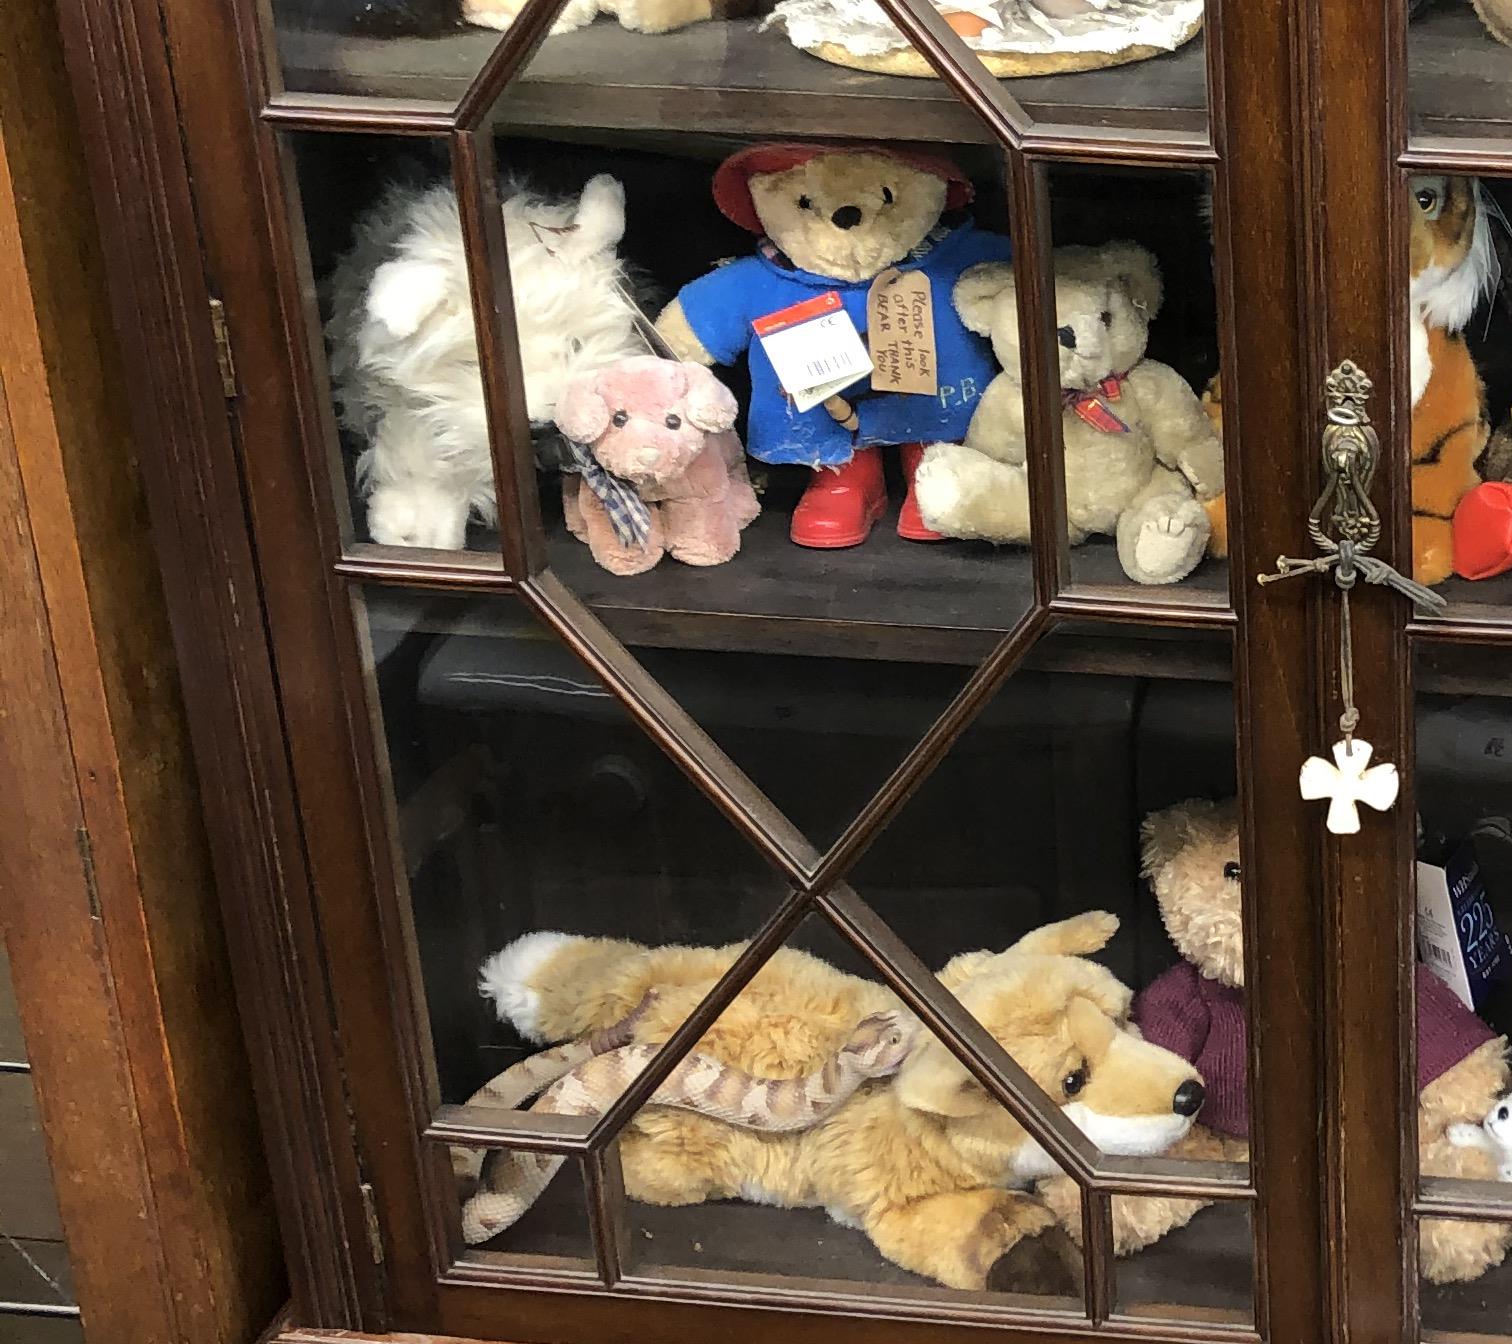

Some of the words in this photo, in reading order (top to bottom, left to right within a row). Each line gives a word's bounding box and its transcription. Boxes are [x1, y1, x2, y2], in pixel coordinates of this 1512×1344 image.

[876, 293, 891, 332] BEAR
[888, 340, 902, 385] THANK
[892, 294, 909, 333] after
[901, 339, 915, 370] this
[911, 290, 926, 339] Please
[918, 348, 930, 377] look
